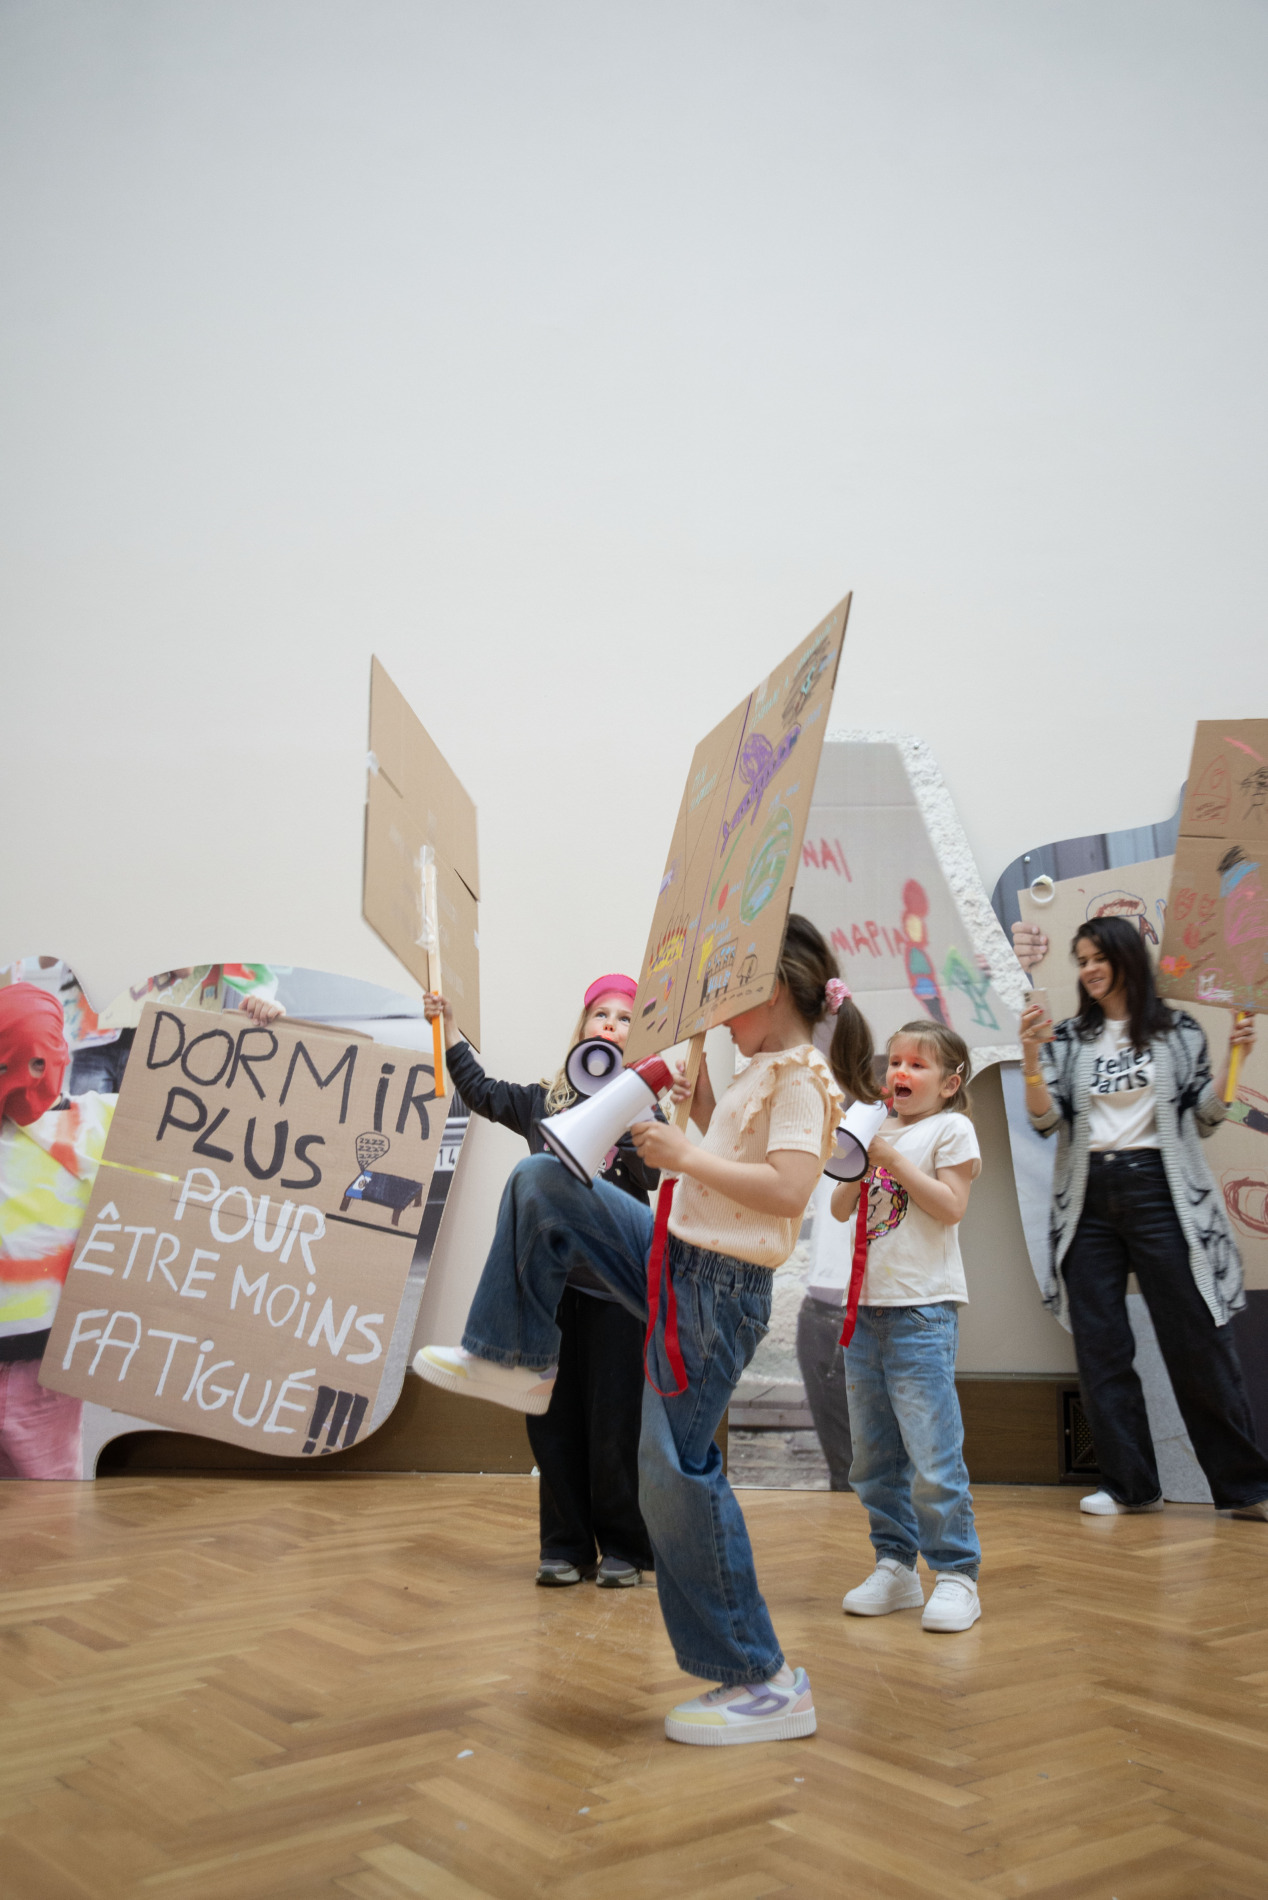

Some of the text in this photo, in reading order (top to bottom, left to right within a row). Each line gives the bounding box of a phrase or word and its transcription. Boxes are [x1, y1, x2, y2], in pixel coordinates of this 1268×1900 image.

[156, 1087, 326, 1189] PLUS
[73, 1201, 220, 1299] ÊTRE
[174, 1167, 327, 1275] POUR
